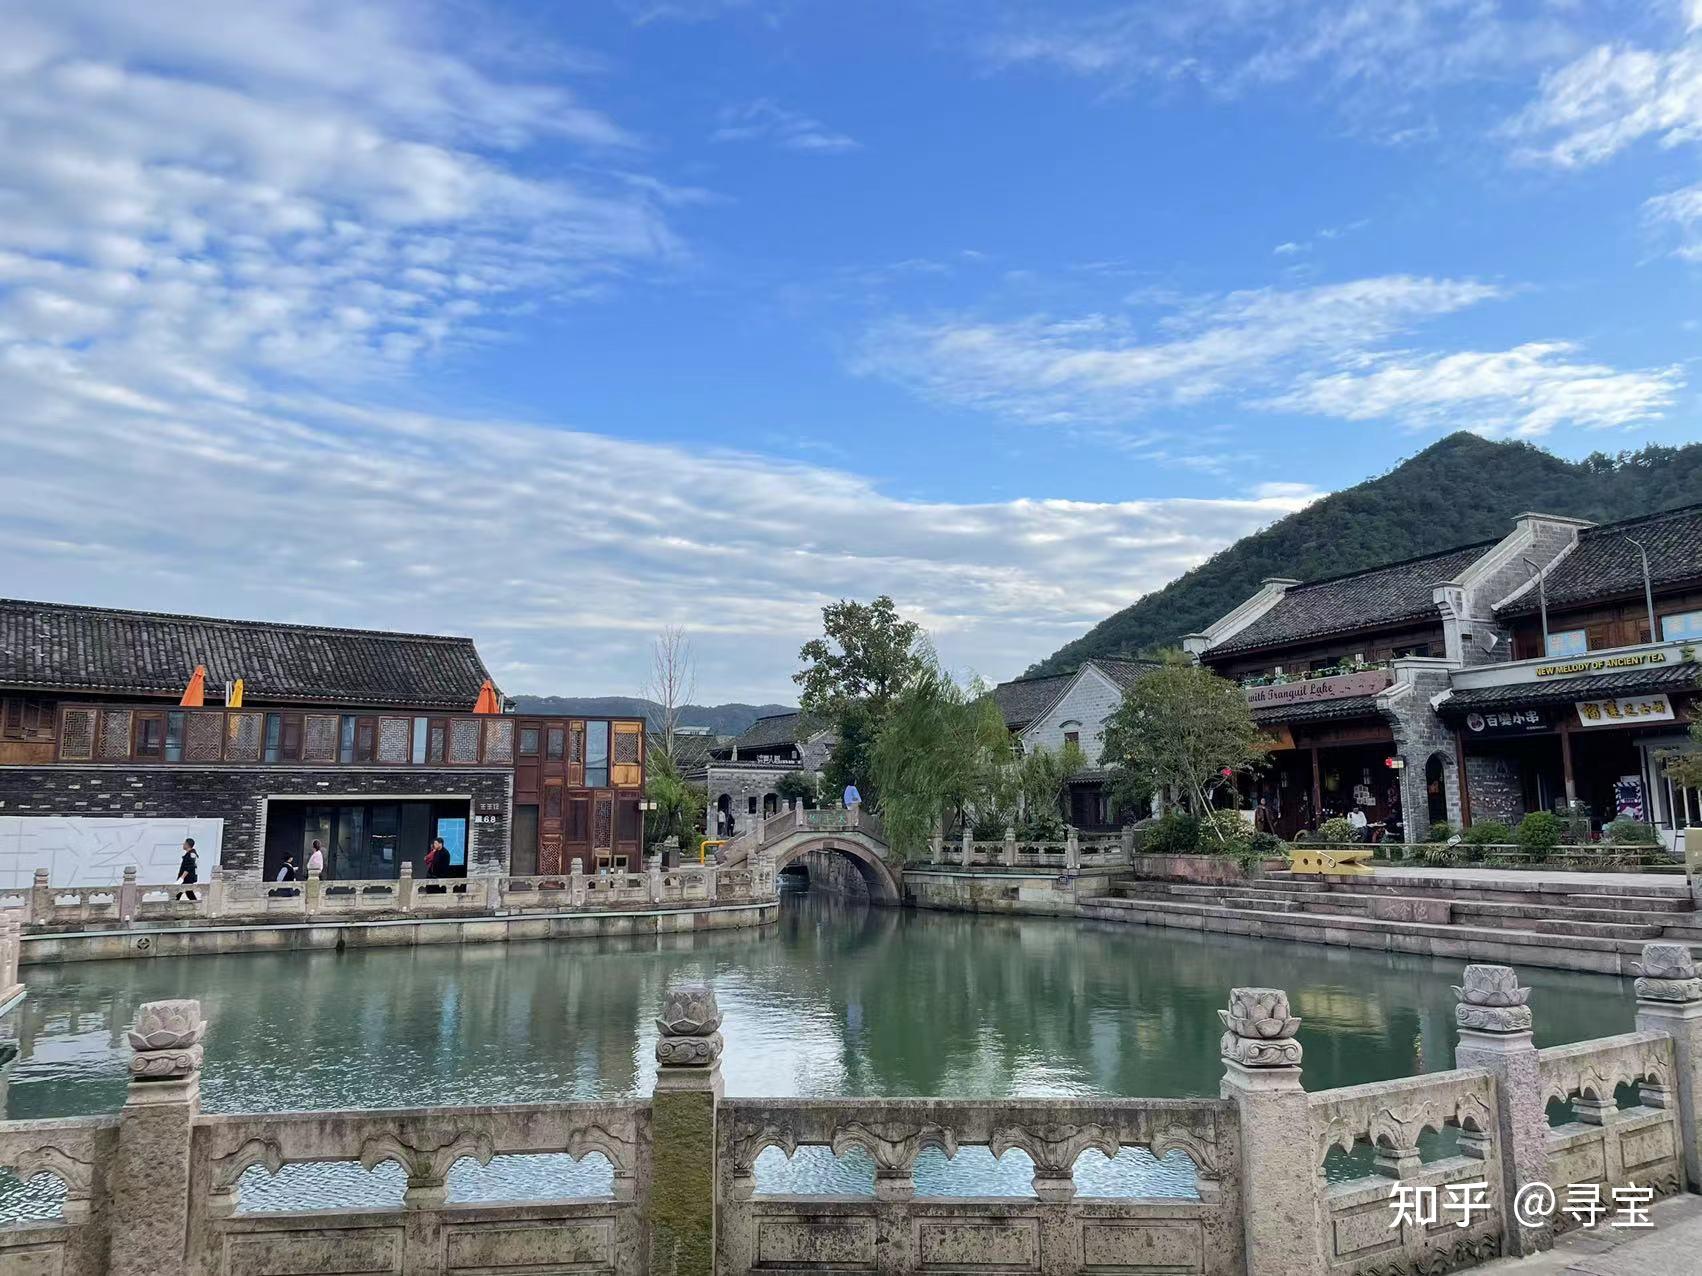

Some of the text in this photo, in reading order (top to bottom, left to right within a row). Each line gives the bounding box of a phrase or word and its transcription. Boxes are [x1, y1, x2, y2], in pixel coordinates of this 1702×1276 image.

[1536, 652, 1666, 677] NEW MELODY OF ANCIENT TEA
[1268, 684, 1307, 702] Tranquil
[1310, 683, 1333, 697] Lake
